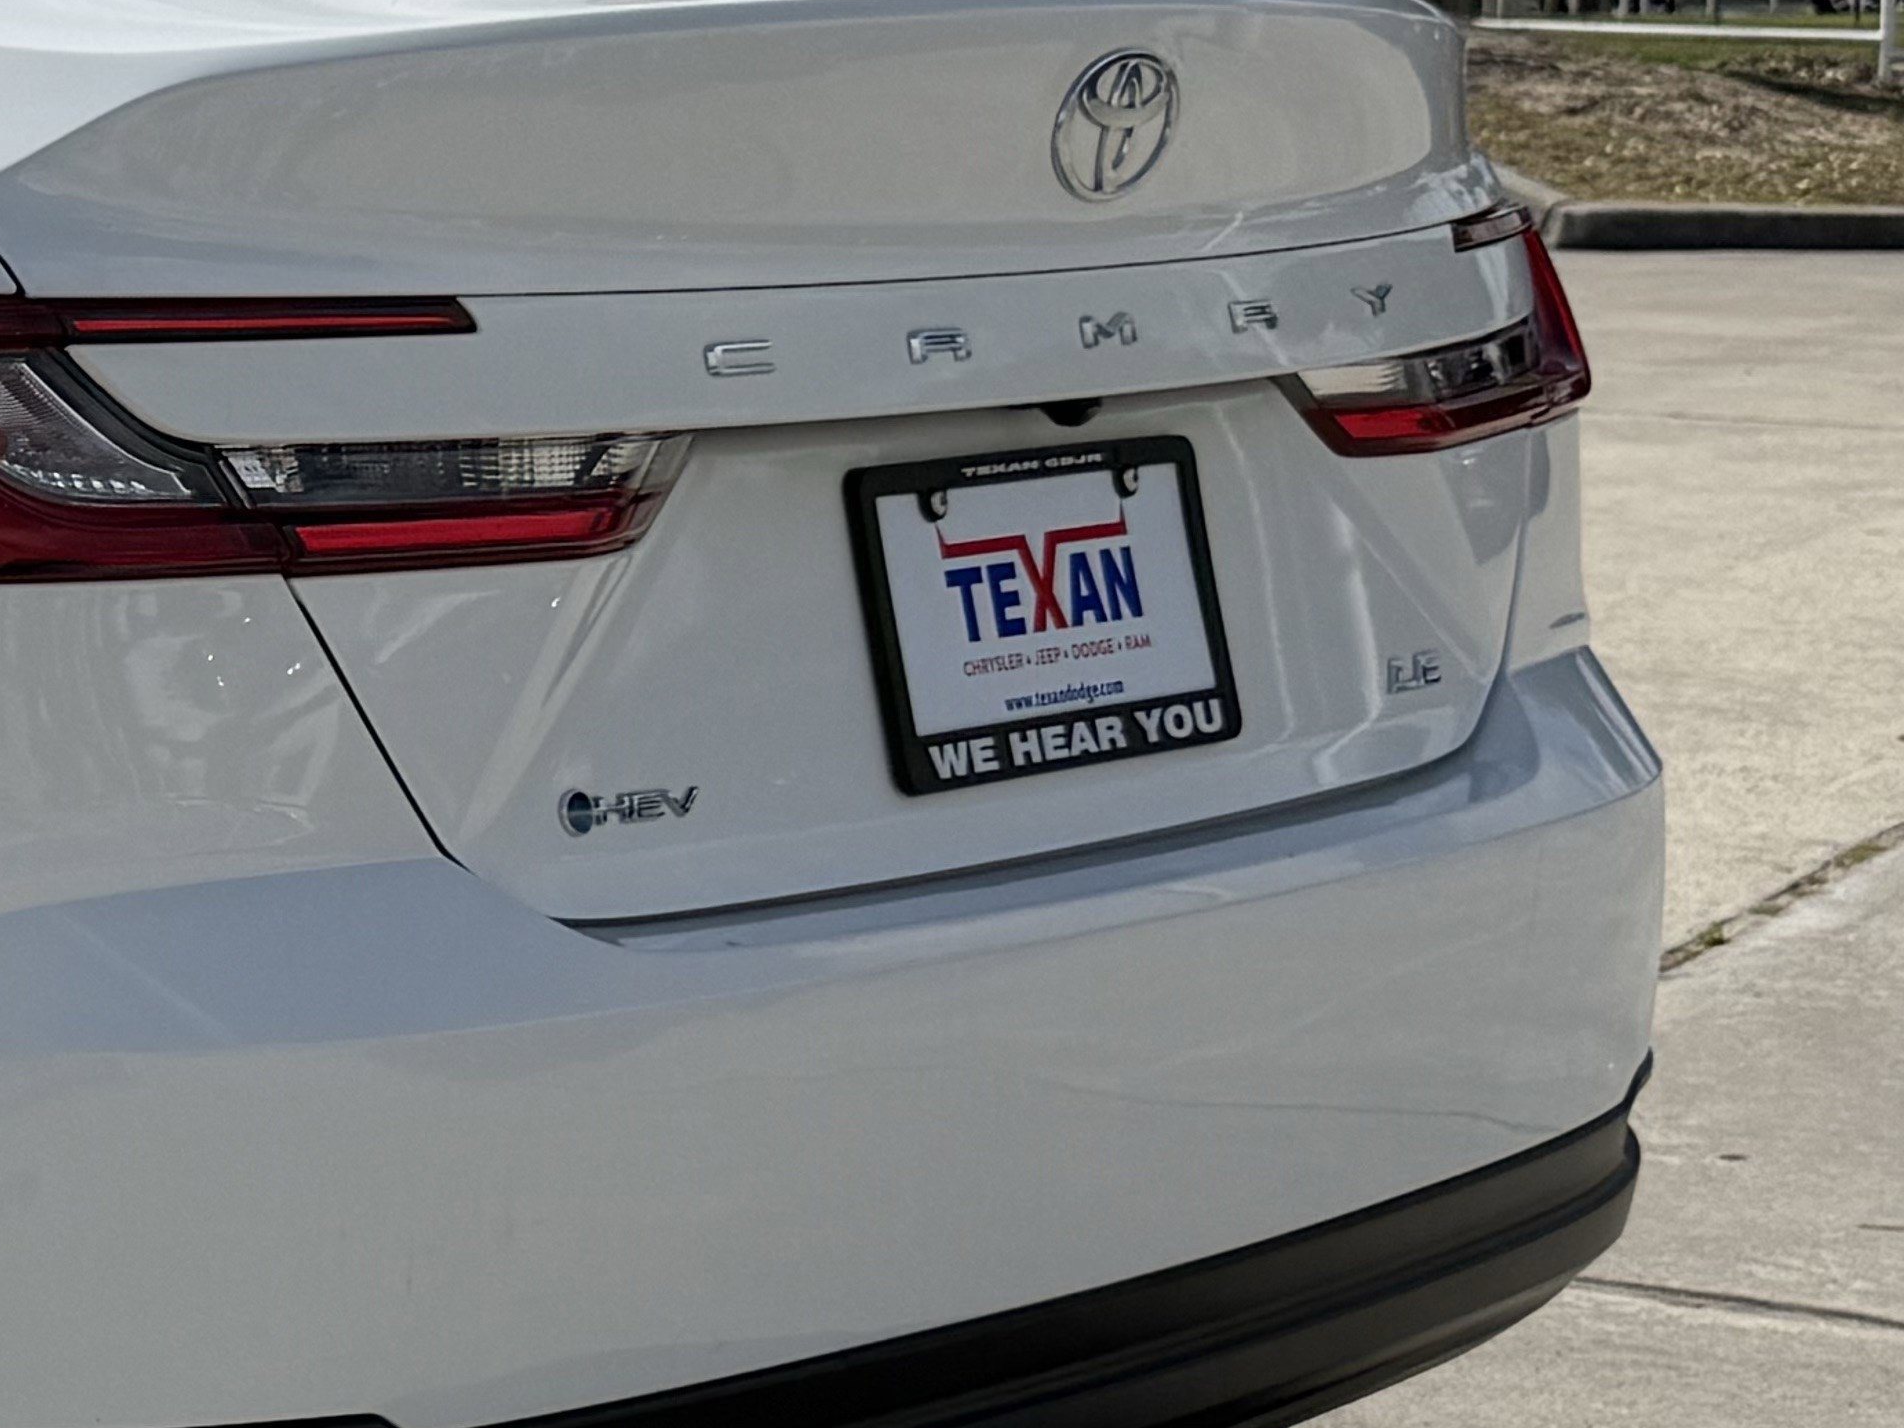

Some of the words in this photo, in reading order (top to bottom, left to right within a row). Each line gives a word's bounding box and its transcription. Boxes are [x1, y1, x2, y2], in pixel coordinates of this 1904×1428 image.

[703, 282, 1393, 378] CAMRY
[960, 460, 1040, 479] TEXAN
[944, 527, 1143, 642] TEXAN
[963, 652, 1024, 677] CHRYSLER
[1035, 646, 1061, 666] JEEP
[1072, 637, 1115, 660] DODGE
[1125, 633, 1152, 651] RAM
[1004, 679, 1125, 712] www.texandodge.com
[928, 738, 1000, 781] WE
[1008, 716, 1129, 769] HEAR
[1132, 698, 1223, 745] YOU
